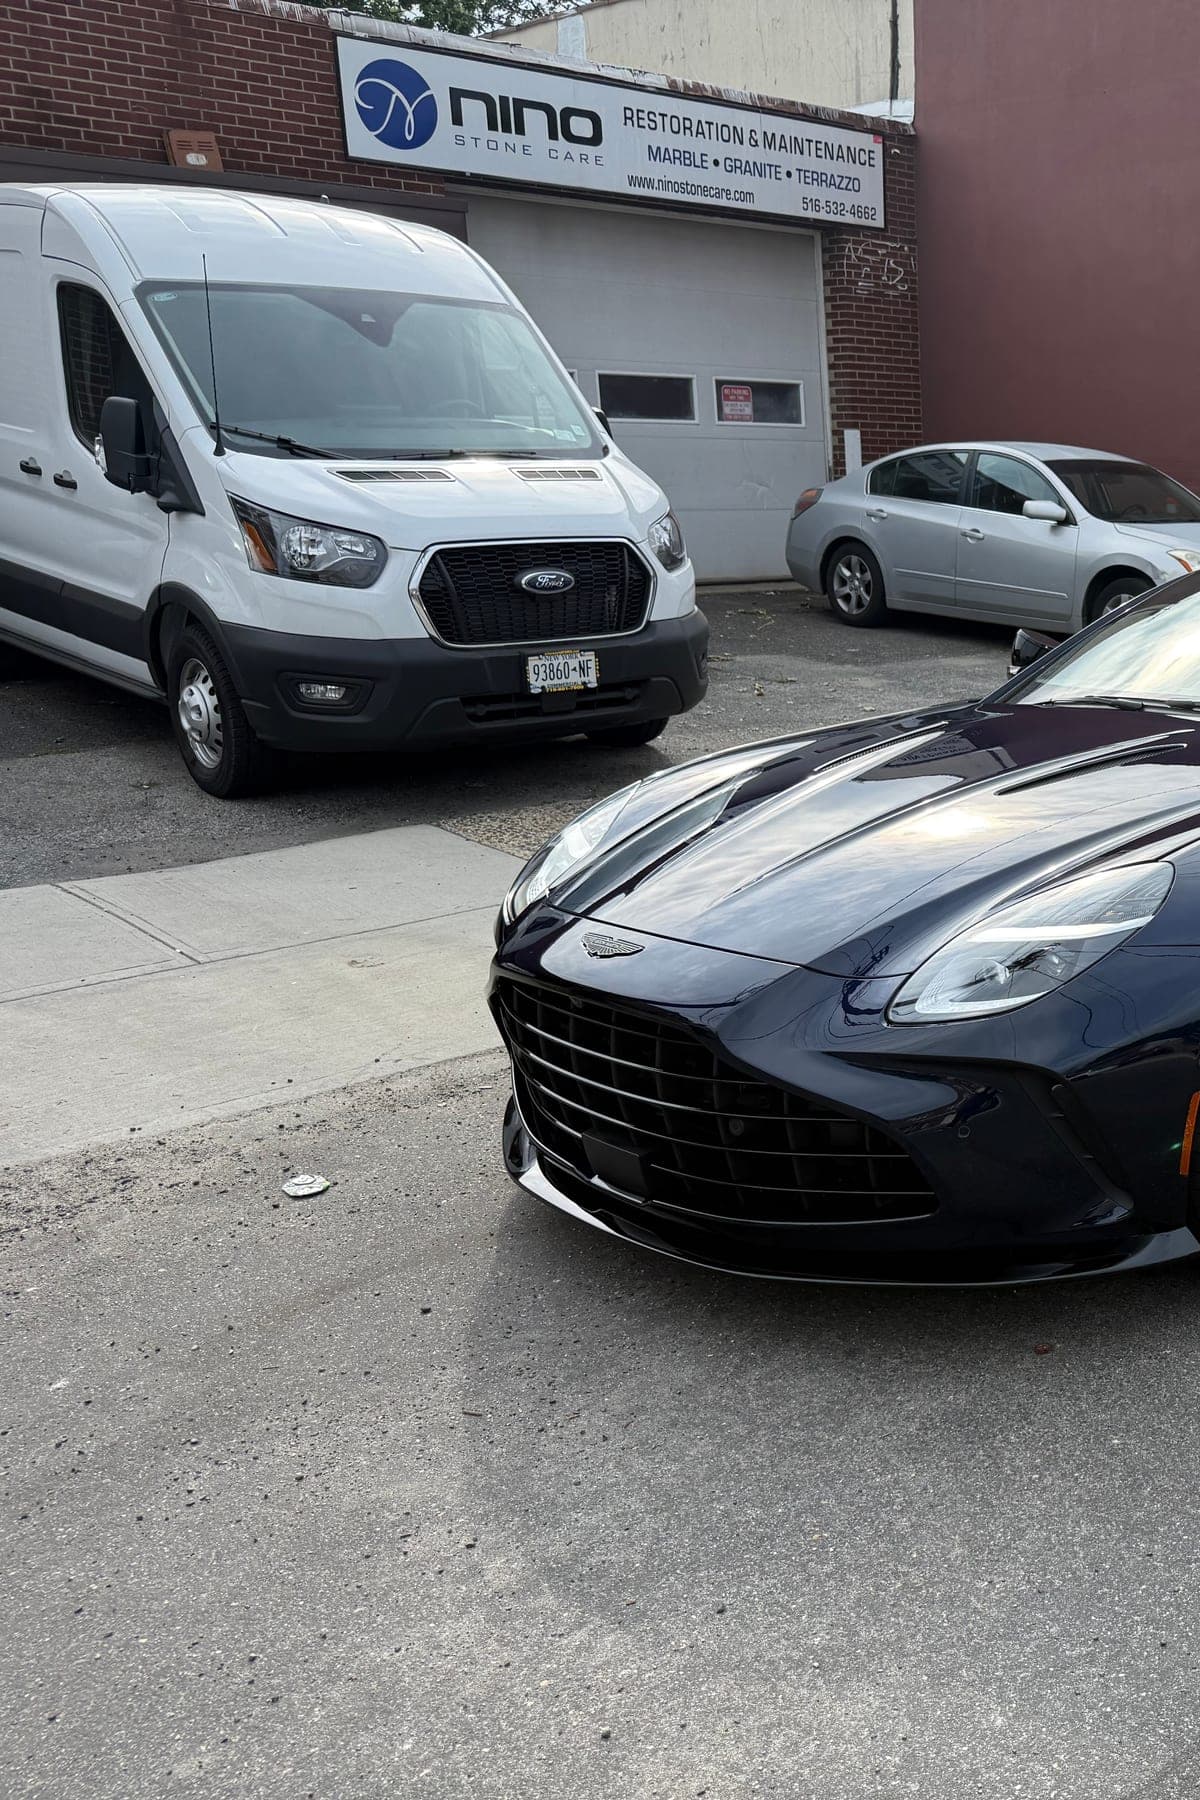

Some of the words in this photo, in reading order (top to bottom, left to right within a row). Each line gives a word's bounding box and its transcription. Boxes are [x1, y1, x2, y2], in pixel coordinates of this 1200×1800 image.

[454, 134, 533, 156] STONE
[548, 148, 604, 167] CARE
[623, 106, 744, 146] RESTORATION
[748, 129, 759, 148] &
[763, 131, 876, 168] MAINTENANCE
[647, 144, 709, 170] MARBLE
[723, 157, 783, 181] GRANITE
[795, 167, 861, 193] TERRAZZO
[627, 174, 755, 204] www.ninostonecare.com
[801, 196, 877, 221] 516-532-4662
[536, 575, 565, 588] Ford
[543, 655, 560, 663] NEW
[561, 653, 579, 661] YORK
